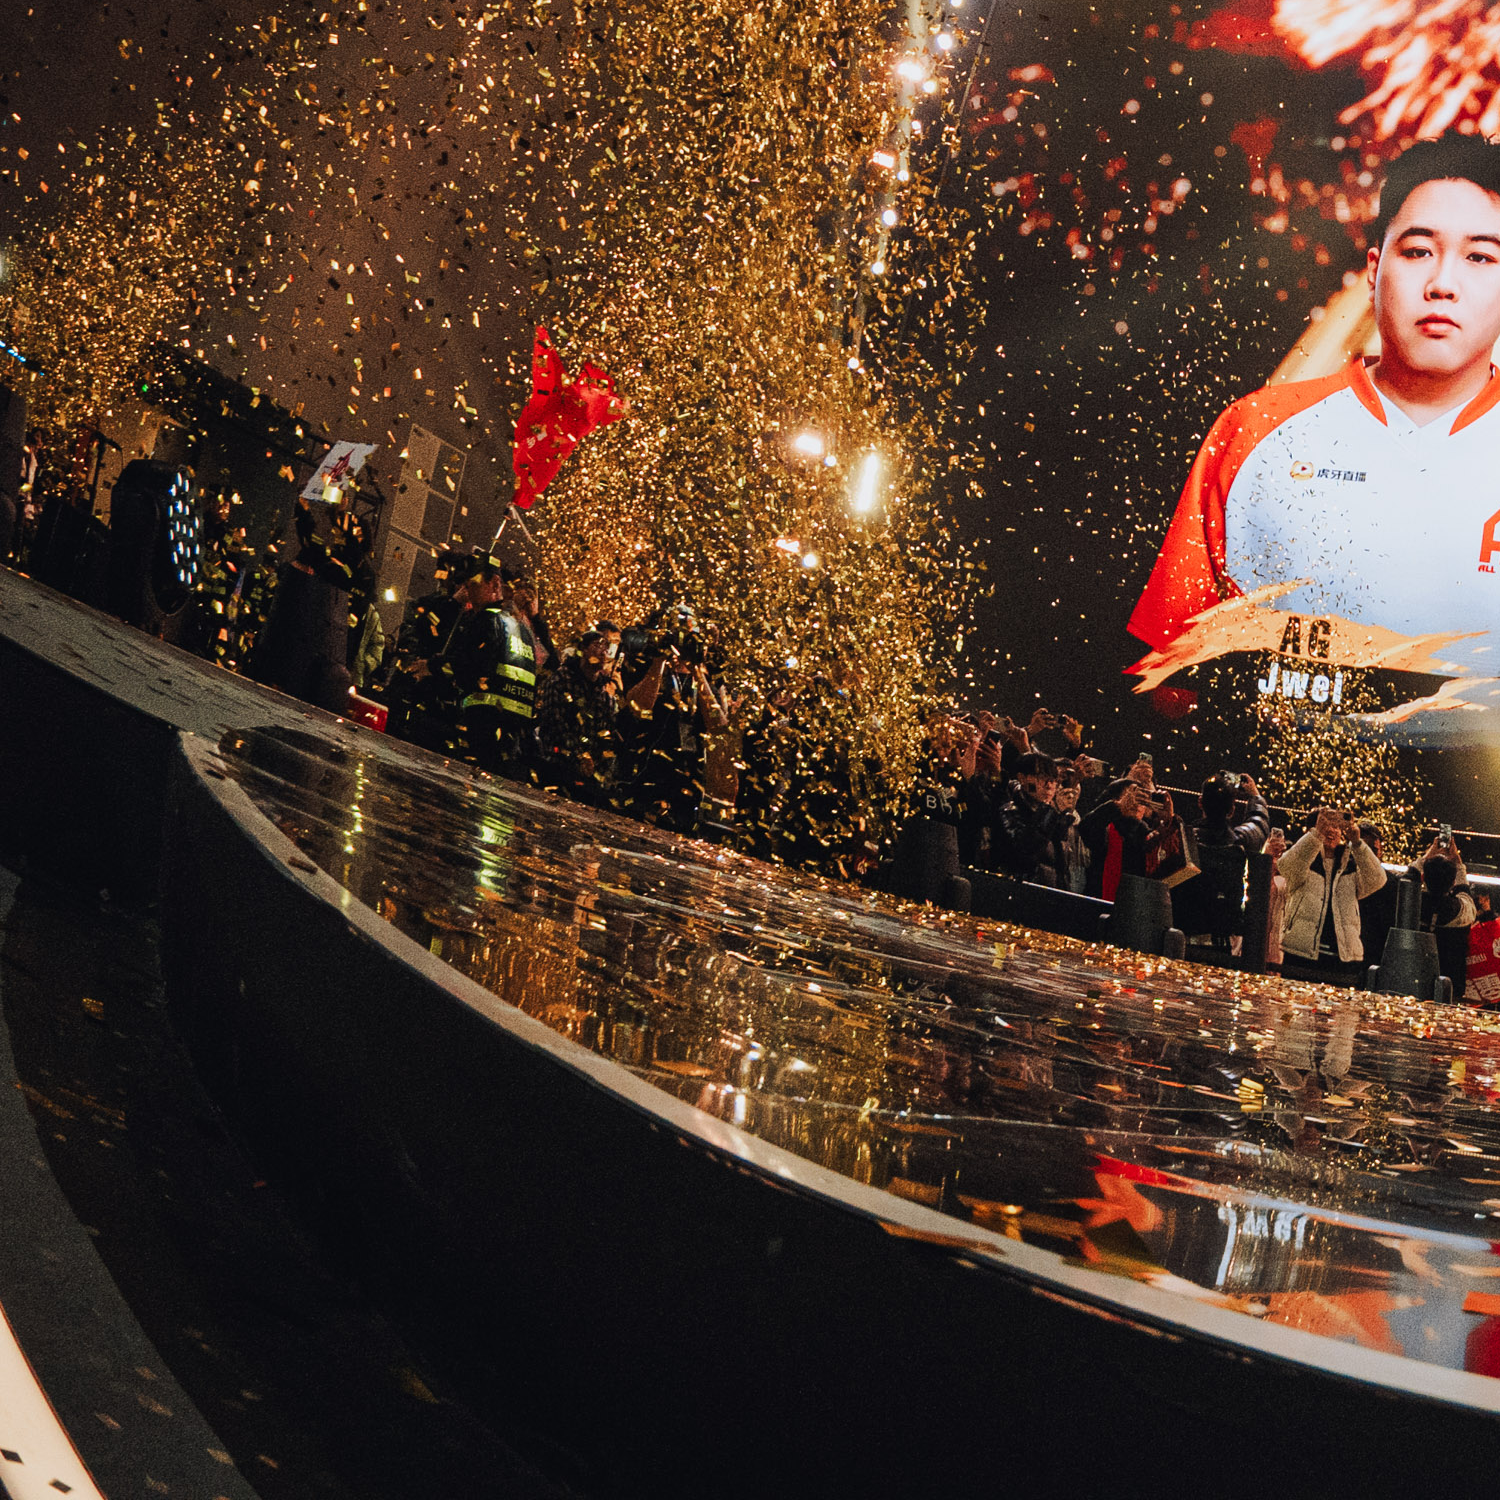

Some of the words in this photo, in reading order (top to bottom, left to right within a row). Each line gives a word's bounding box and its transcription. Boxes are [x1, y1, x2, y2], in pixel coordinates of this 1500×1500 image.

[1317, 468, 1368, 482] 虎牙直播
[1478, 564, 1495, 574] ALL
[1279, 616, 1331, 658] AG
